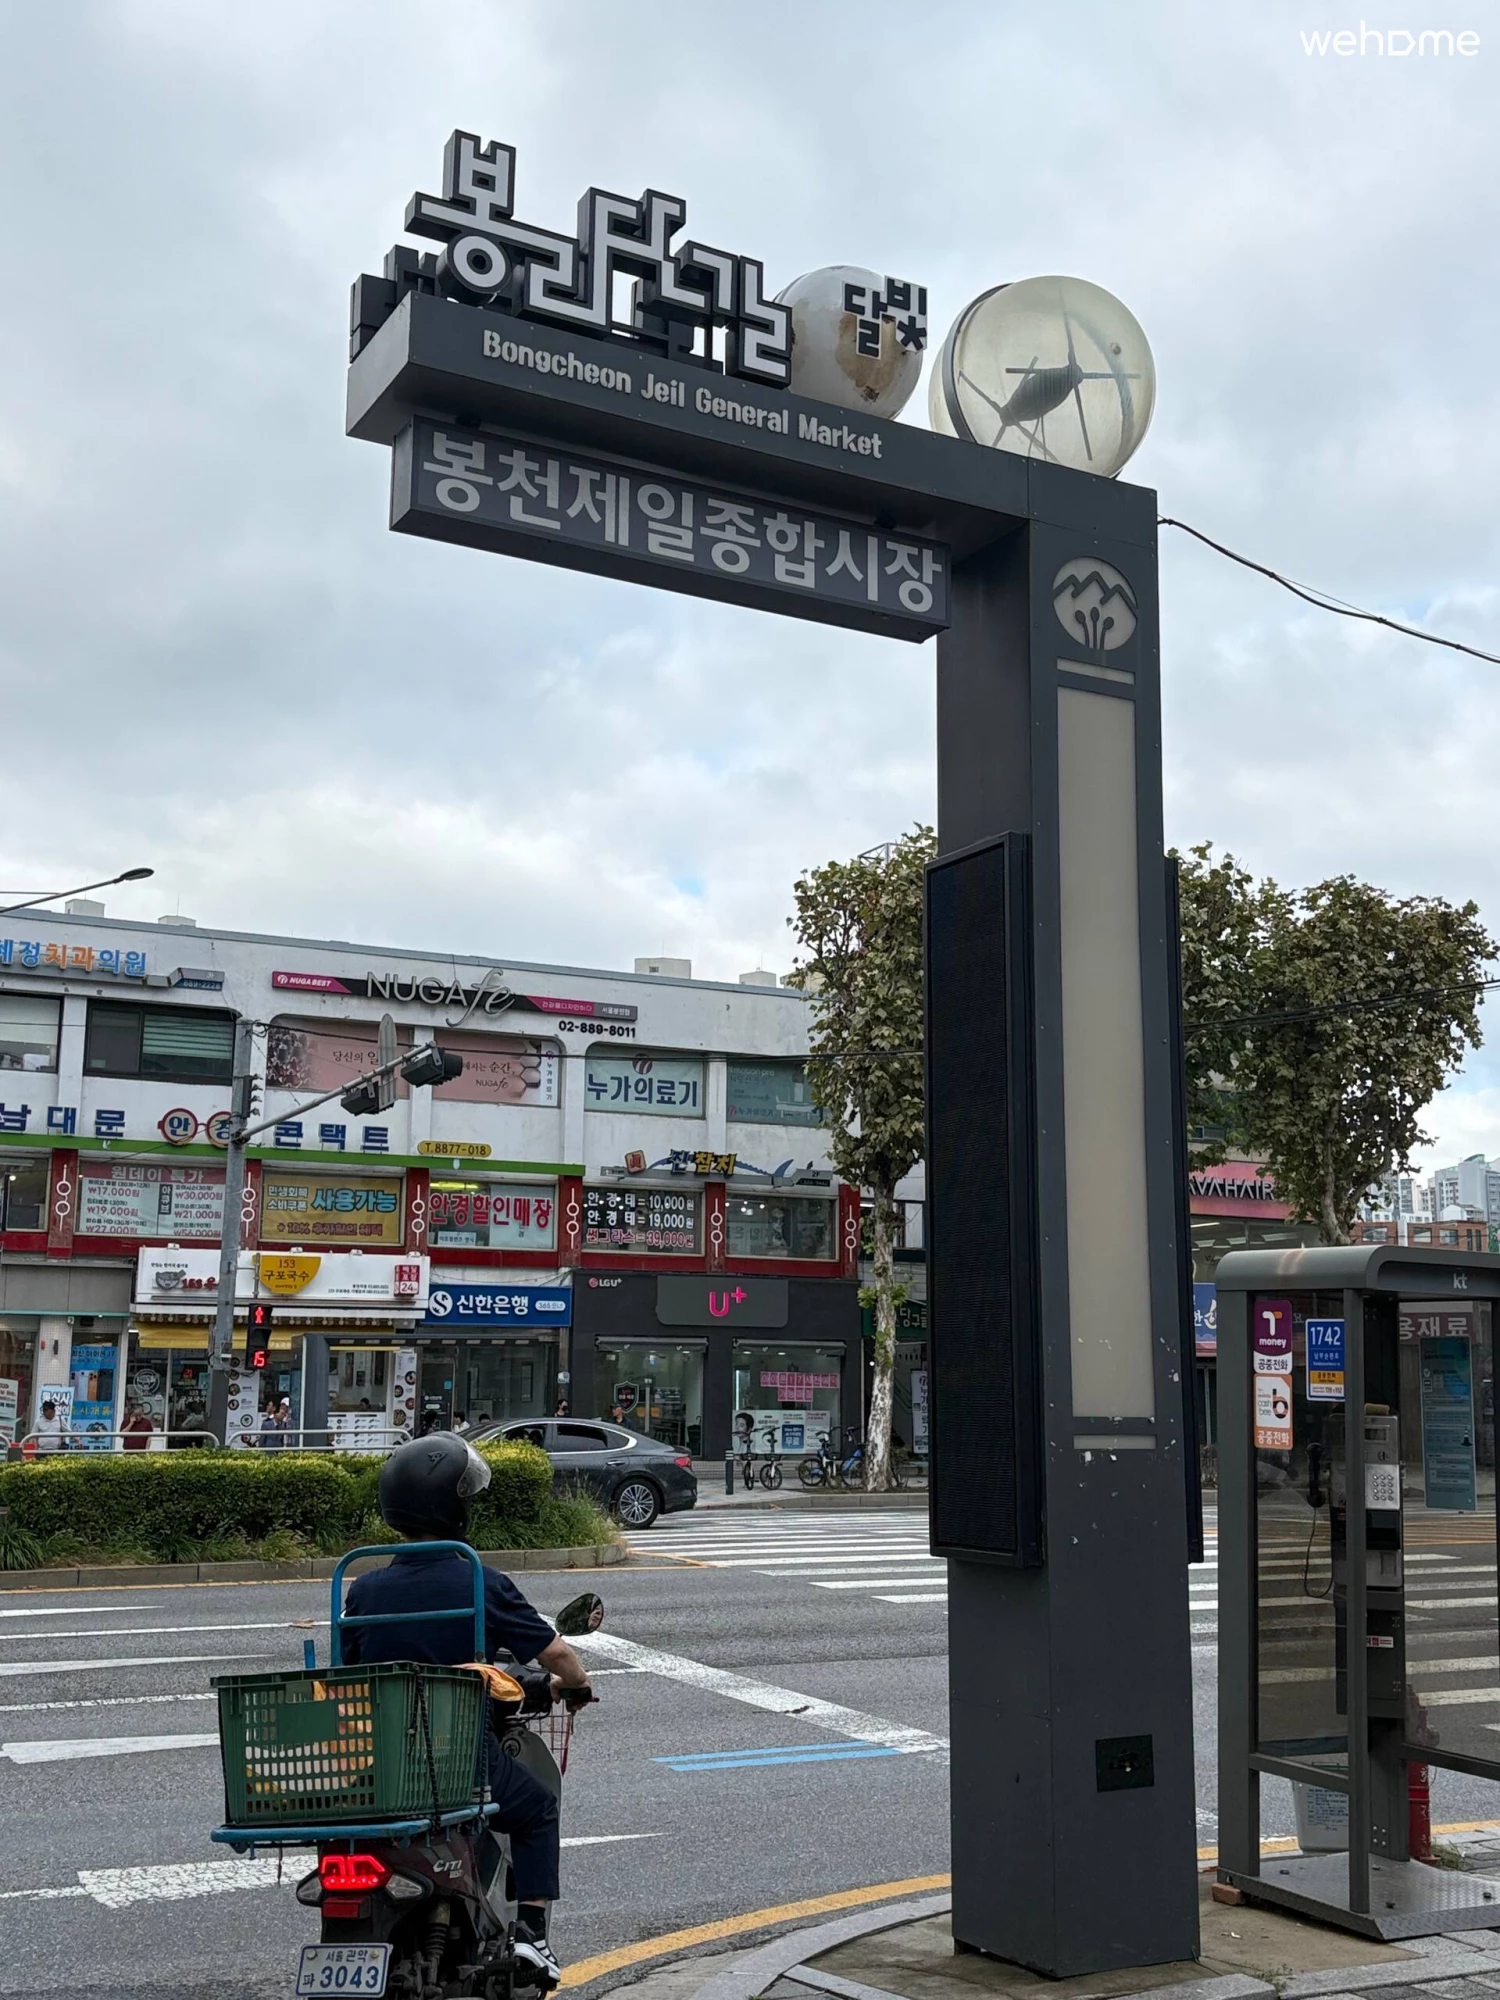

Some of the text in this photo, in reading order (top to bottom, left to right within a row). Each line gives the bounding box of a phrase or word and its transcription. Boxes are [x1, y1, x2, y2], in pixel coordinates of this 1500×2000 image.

[843, 277, 928, 358] 달빛
[482, 329, 883, 459] Bongcheon Jeil General Market
[423, 431, 943, 613] 봉천제일종합시장
[558, 1020, 636, 1038] 02-889-8011
[587, 1073, 698, 1107] 누가의료기
[274, 1121, 390, 1151] 콘택트
[312, 1187, 398, 1213] 사용가능
[429, 1193, 552, 1229] 안경할인매장
[279, 1259, 296, 1268] 153
[263, 1270, 310, 1282] 구포국수
[1453, 1273, 1468, 1289] kt
[456, 1294, 529, 1316] 신한은행
[709, 1286, 747, 1317] U+
[1259, 1338, 1287, 1349] money
[1310, 1327, 1341, 1346] 1742
[253, 1351, 265, 1367] 15
[1258, 1358, 1288, 1371] 공중전화
[1257, 1430, 1289, 1445] 공중전화
[319, 1965, 380, 1989] 3043
